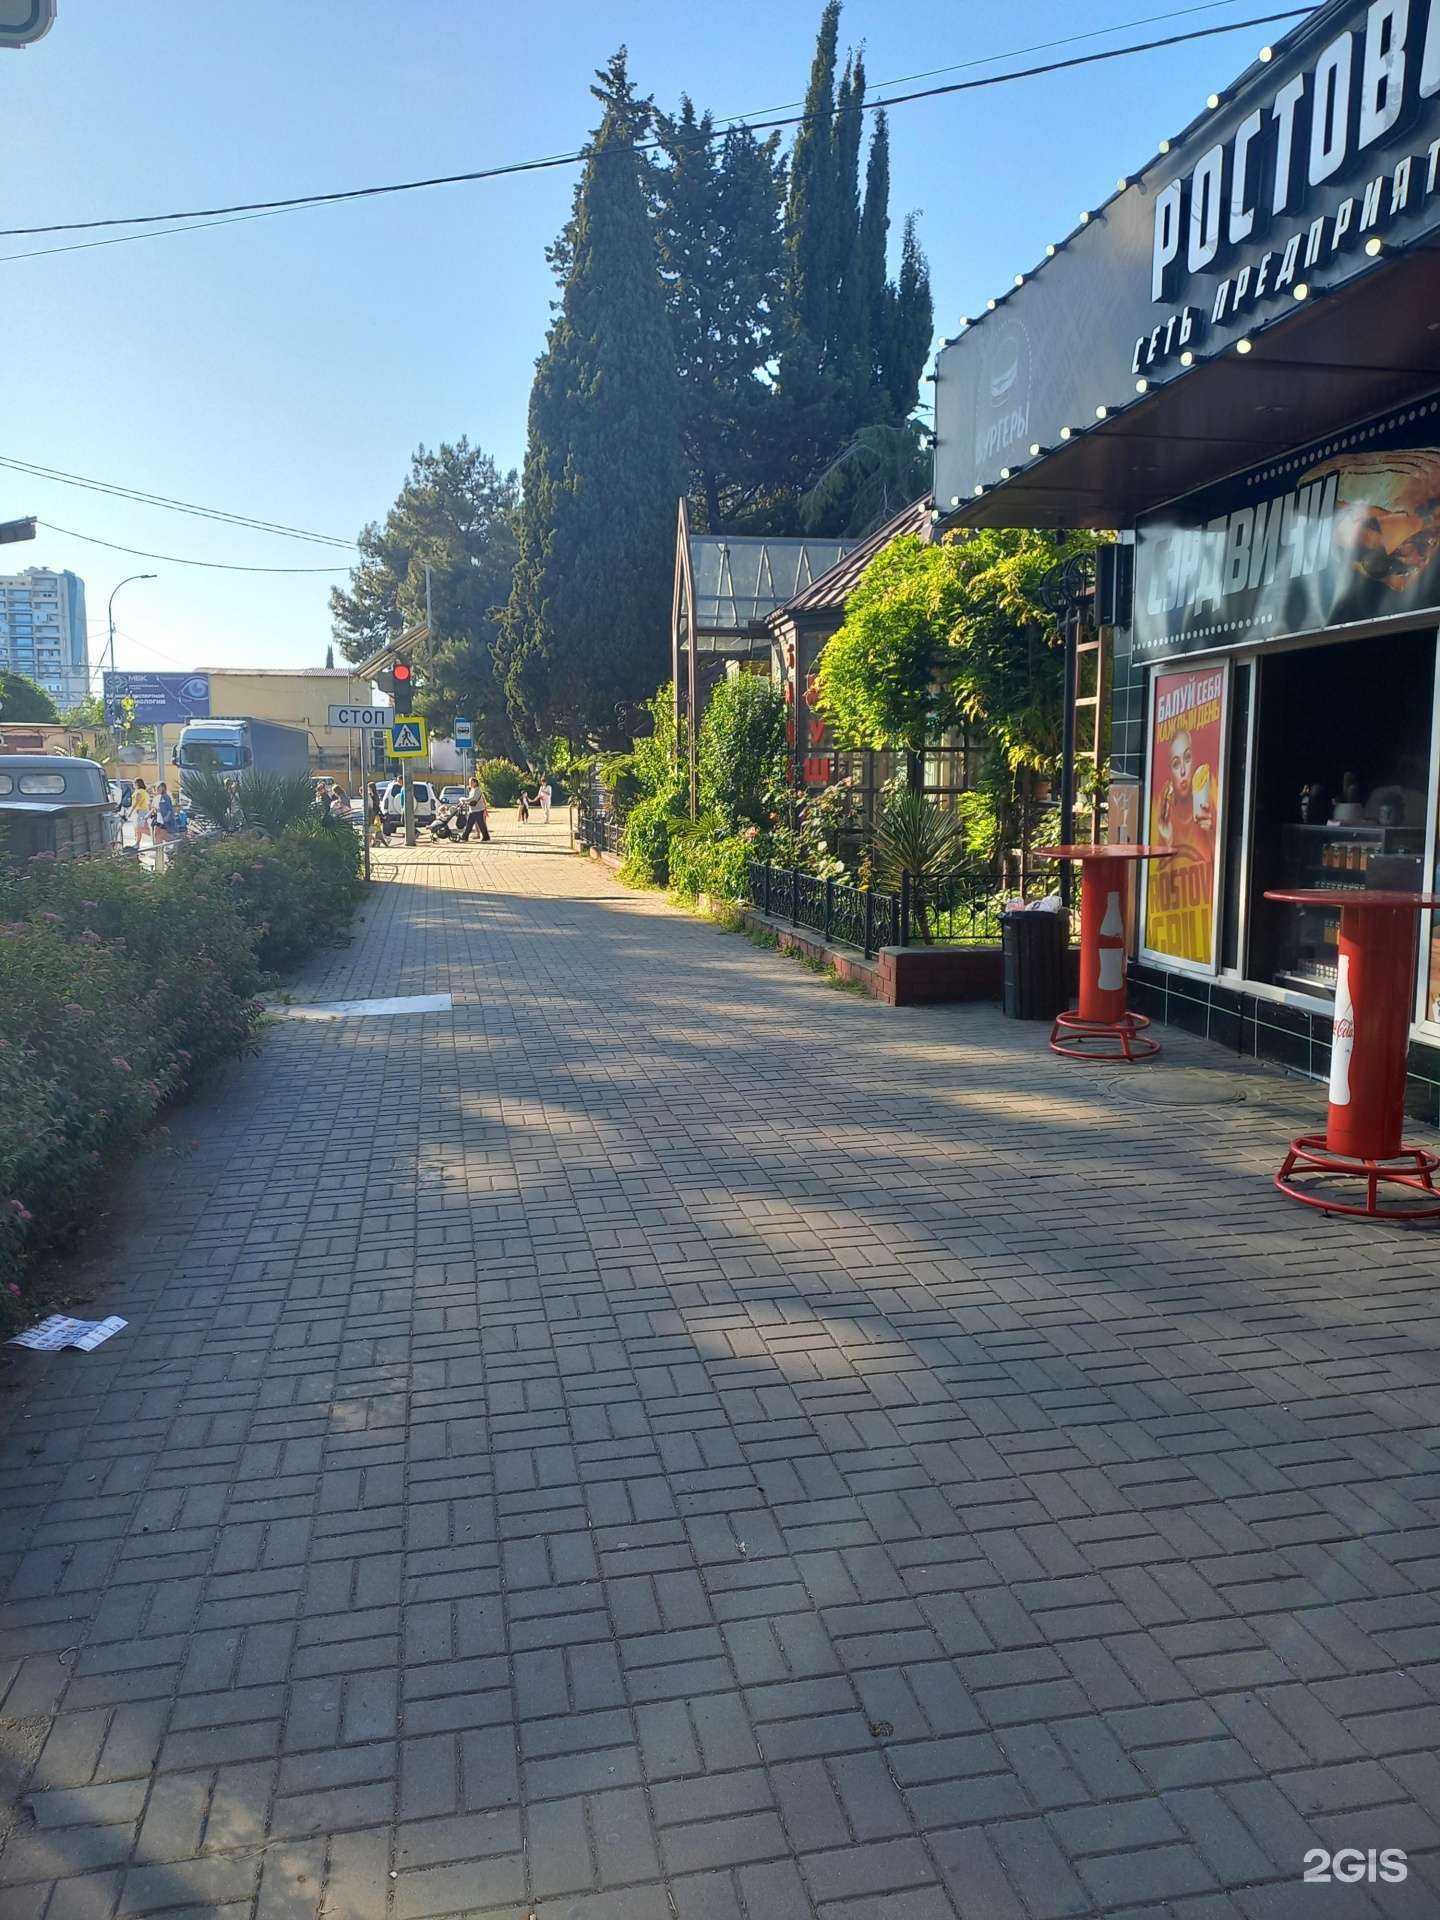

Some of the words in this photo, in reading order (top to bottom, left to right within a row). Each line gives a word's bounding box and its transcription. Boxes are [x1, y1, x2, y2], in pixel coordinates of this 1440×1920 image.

[1131, 306, 1194, 375] СЕТЬ
[338, 710, 385, 724] СТОП
[1157, 675, 1197, 722] БАЛУЙ
[1196, 672, 1223, 704] СЕБЯ
[1196, 697, 1221, 731] ДЕНЬ
